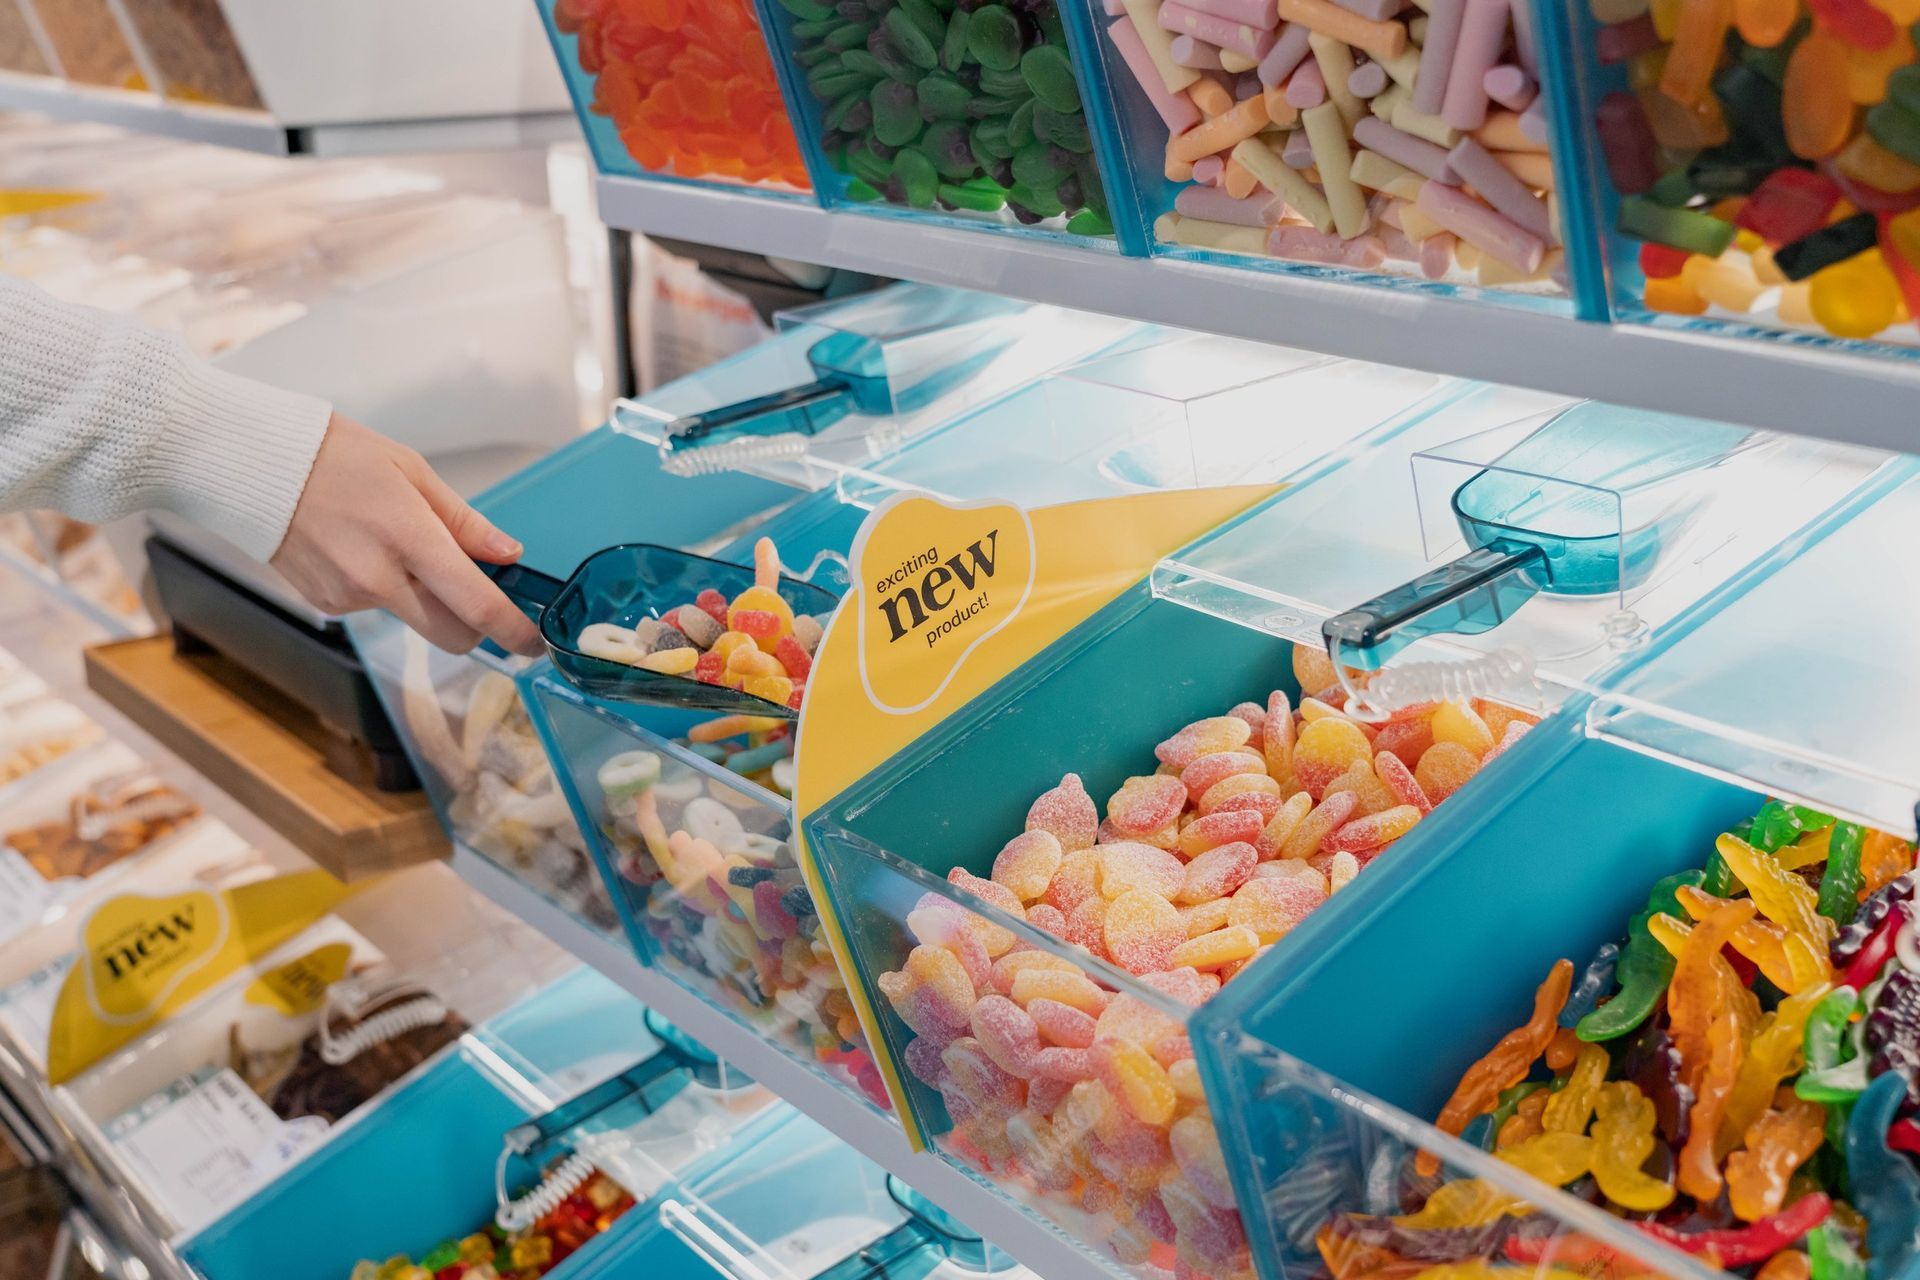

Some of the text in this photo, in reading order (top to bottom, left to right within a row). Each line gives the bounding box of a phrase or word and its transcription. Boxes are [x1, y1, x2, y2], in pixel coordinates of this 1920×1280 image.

[876, 546, 939, 594] exciting
[878, 529, 999, 643] new
[926, 591, 989, 648] product!
[104, 902, 195, 980] new
